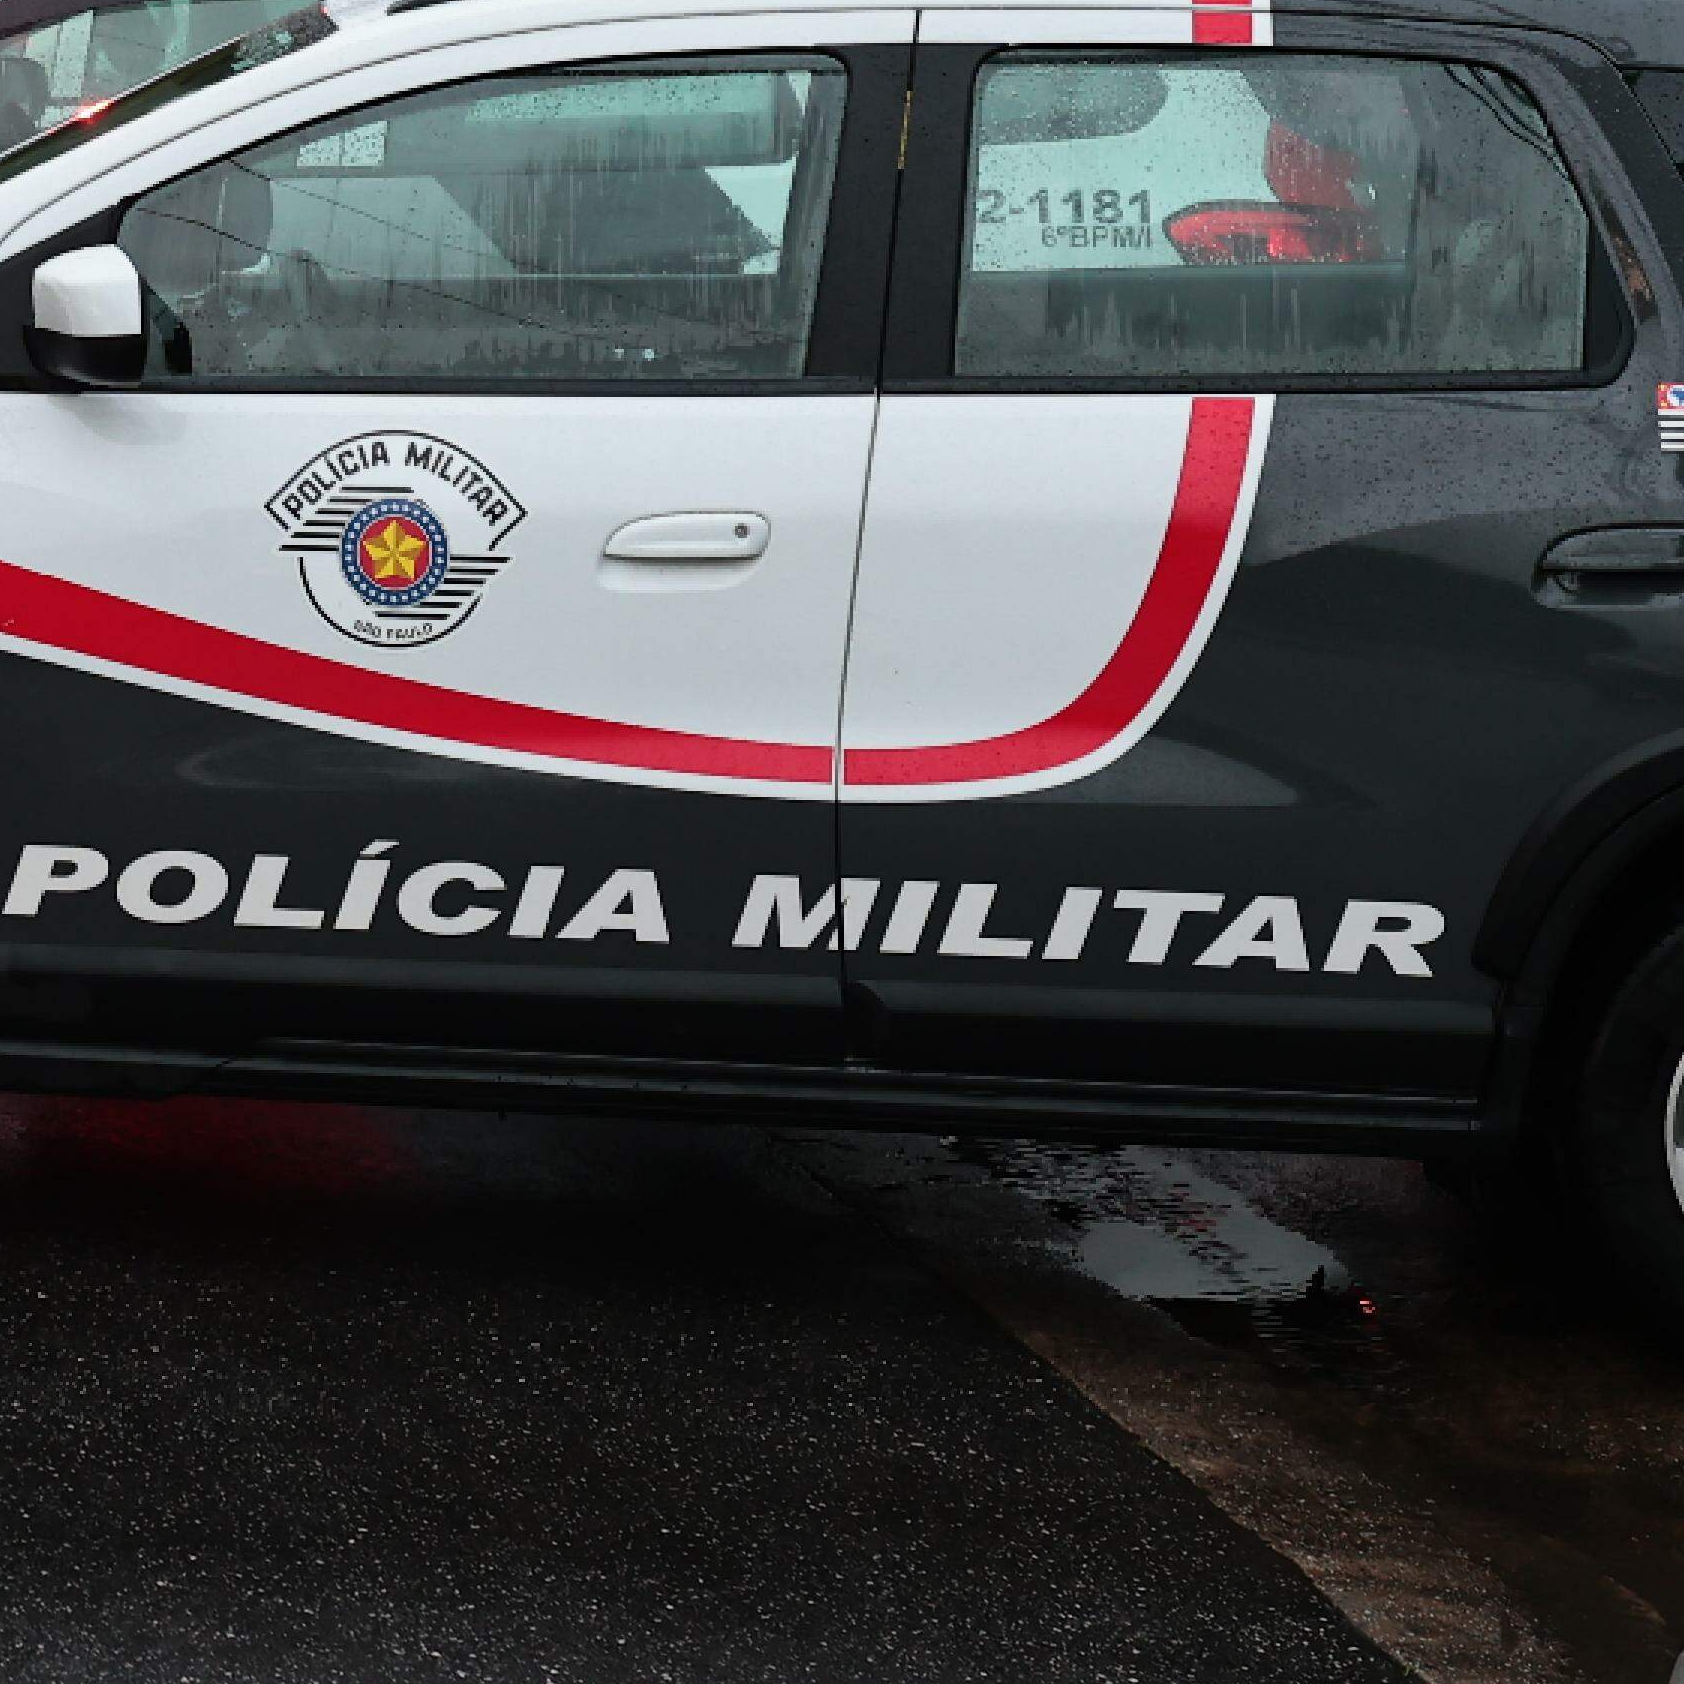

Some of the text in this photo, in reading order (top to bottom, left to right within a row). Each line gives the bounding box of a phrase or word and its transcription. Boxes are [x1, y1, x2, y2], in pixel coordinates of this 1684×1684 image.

[404, 441, 508, 526] MILITAR
[1, 838, 1445, 978] POLÍCIA MILITAR
